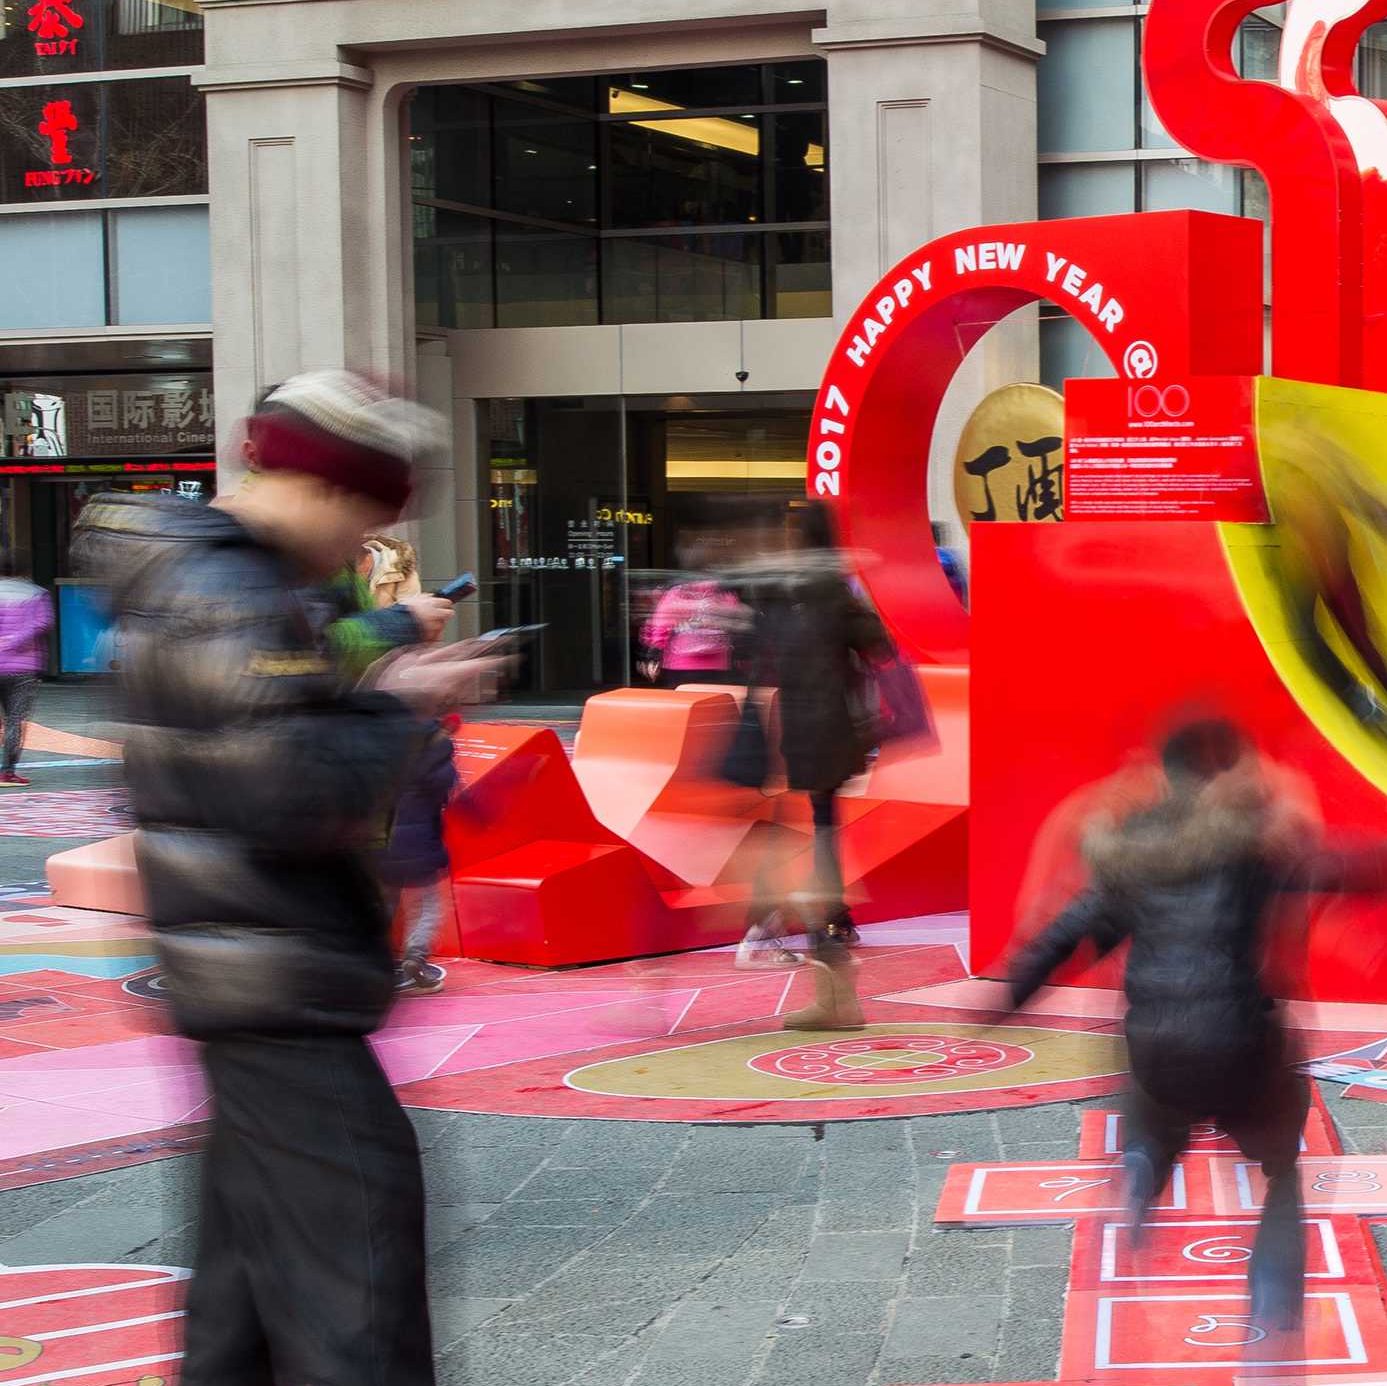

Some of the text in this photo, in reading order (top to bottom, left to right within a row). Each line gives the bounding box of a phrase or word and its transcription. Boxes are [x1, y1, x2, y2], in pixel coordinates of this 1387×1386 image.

[815, 384, 851, 496] 2017
[845, 261, 932, 367] HAPPY
[954, 242, 1026, 275] NEW
[1045, 252, 1125, 333] YEAR
[88, 433, 173, 445] International
